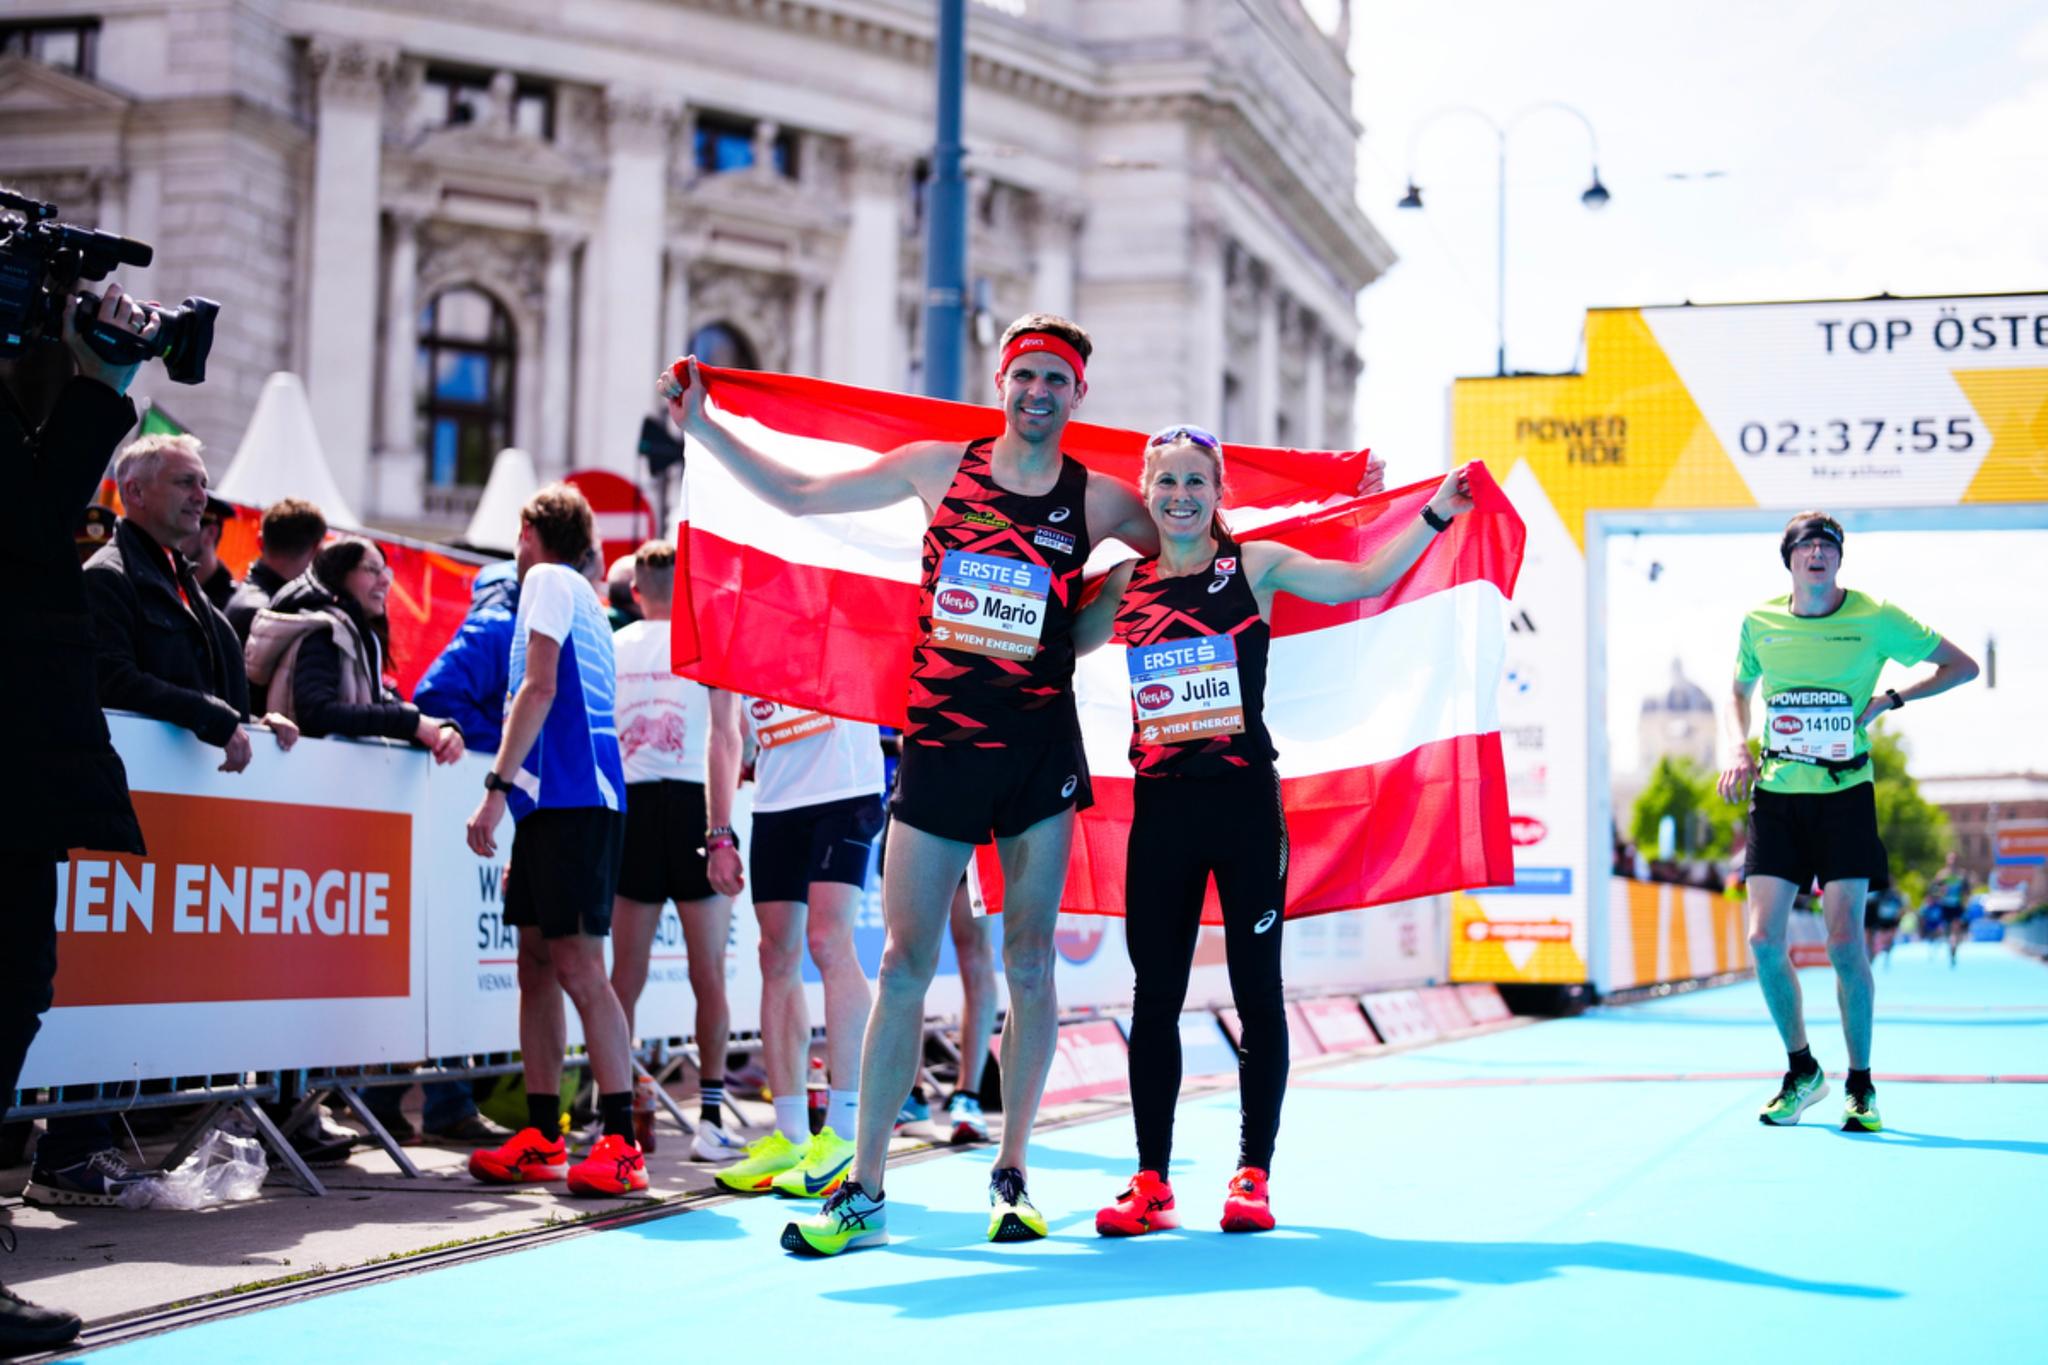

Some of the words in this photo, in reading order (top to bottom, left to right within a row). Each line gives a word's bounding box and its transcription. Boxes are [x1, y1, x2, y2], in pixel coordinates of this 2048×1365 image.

[1817, 319, 1912, 354] TOP
[1739, 418, 1974, 455] 02:37:55
[958, 560, 1012, 583] ERSTE
[983, 596, 1037, 625] Mario
[954, 631, 984, 646] WIEN
[985, 638, 1036, 656] ENERGIE
[1143, 648, 1195, 670] ERSTE
[1181, 677, 1230, 702] Julia
[1771, 692, 1848, 705] POWERADE
[1161, 723, 1190, 735] WIEN
[1191, 715, 1241, 730] ENERGIE
[1805, 717, 1851, 731] 1410D
[56, 860, 156, 934] IEN
[173, 863, 390, 936] ENERGIE
